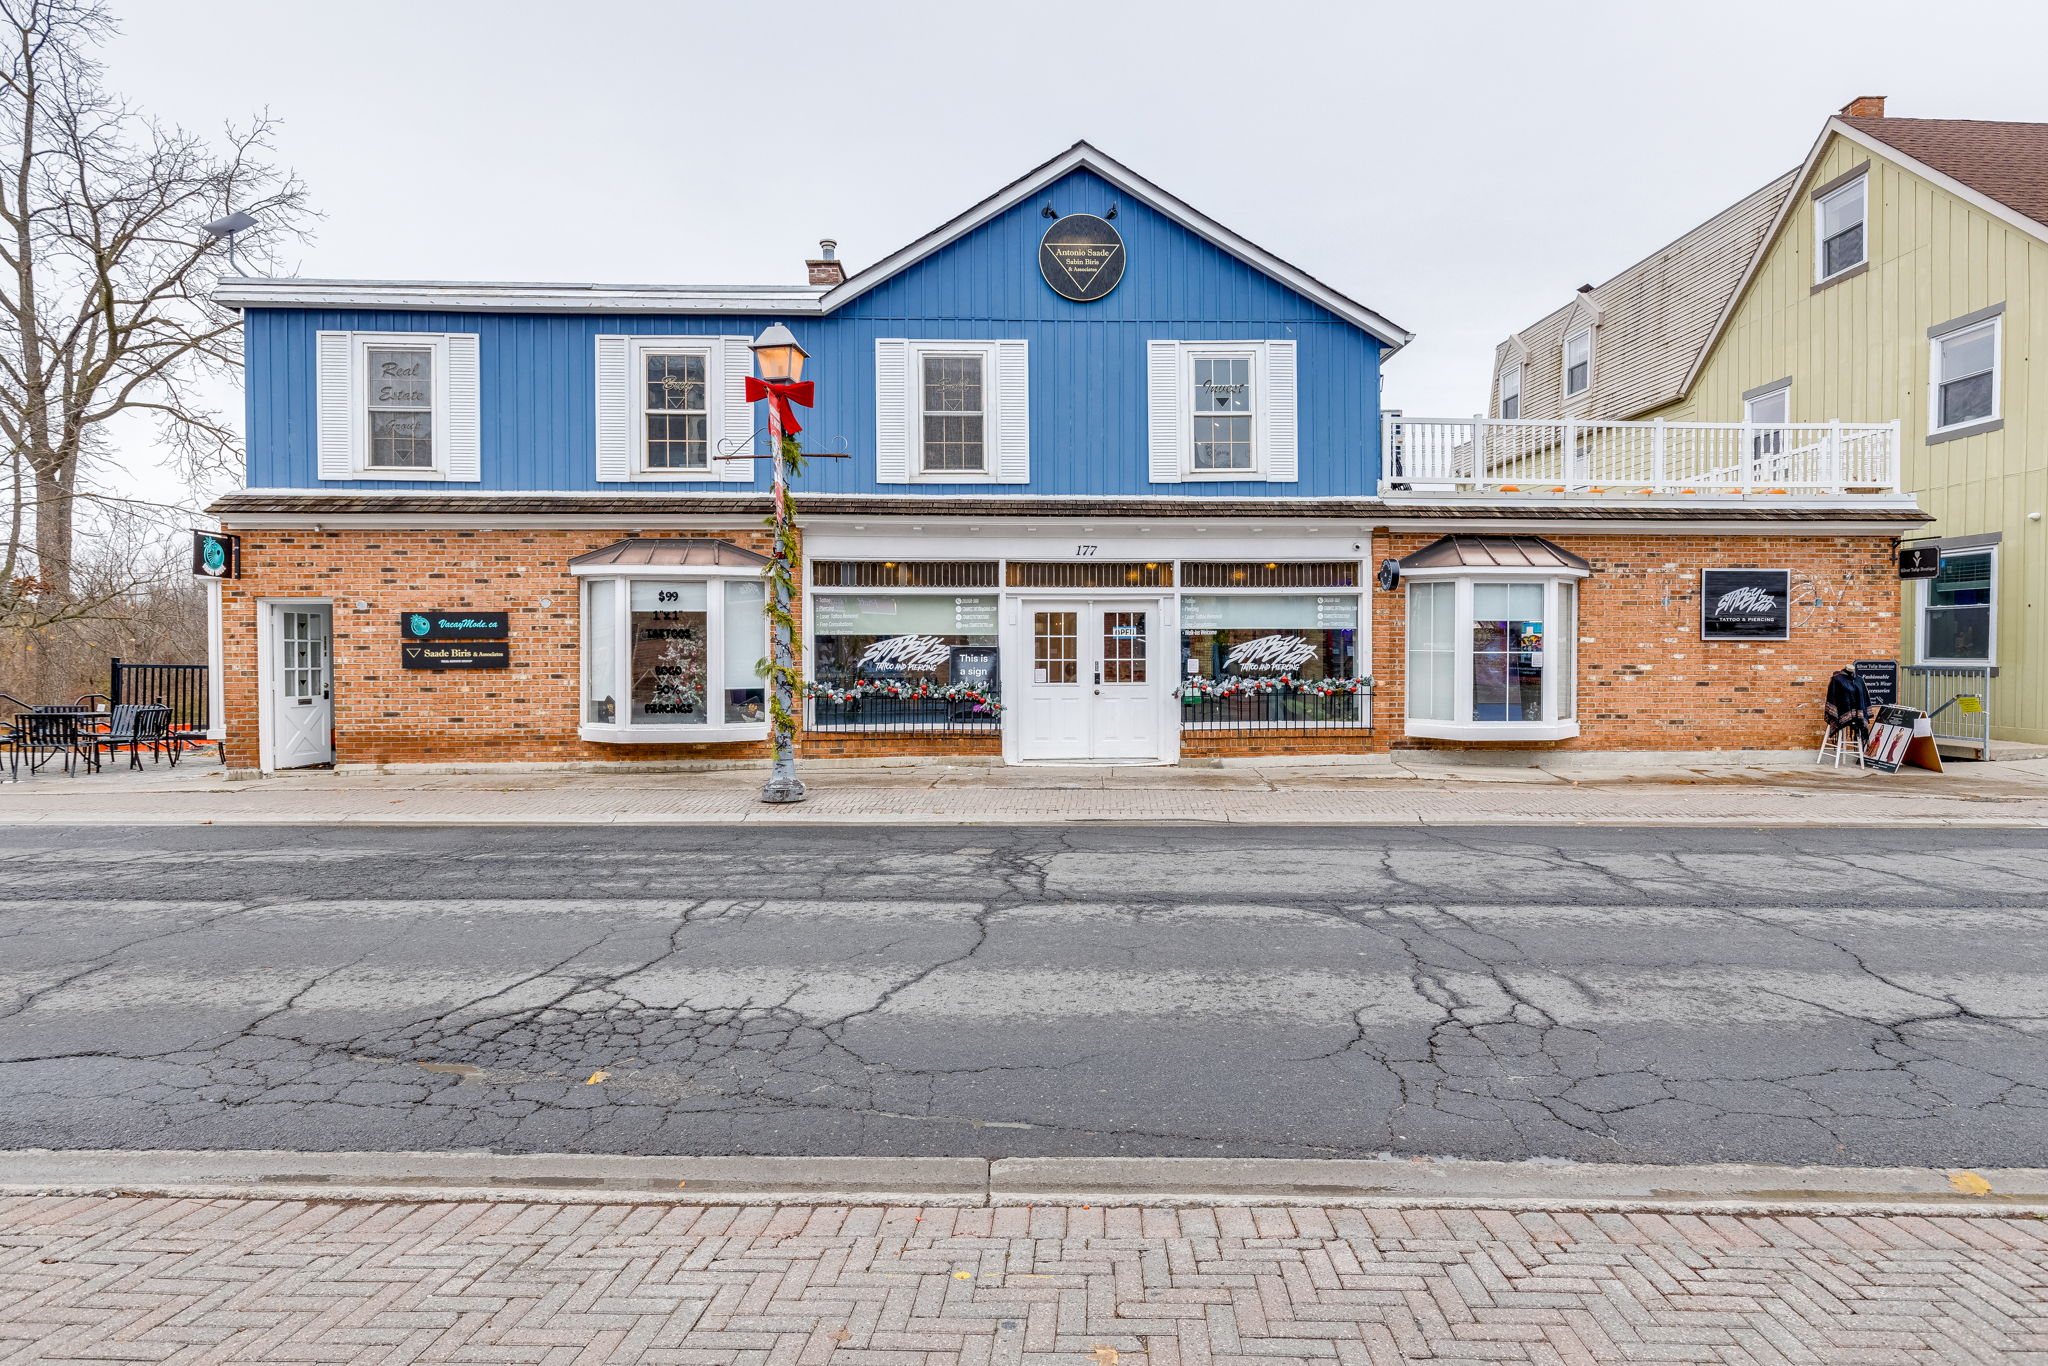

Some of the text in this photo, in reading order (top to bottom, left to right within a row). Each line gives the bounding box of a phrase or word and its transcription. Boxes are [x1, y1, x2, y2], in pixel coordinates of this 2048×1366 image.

[1056, 248, 1110, 256] Antonio Saade
[382, 362, 420, 378] Real
[1203, 380, 1244, 394] Invest
[379, 386, 424, 402] Estate
[1076, 545, 1098, 556] 177
[658, 590, 679, 602] $99
[438, 618, 498, 630] VacayMode.ca
[424, 648, 450, 658] Saade
[450, 648, 472, 658] Biris
[960, 654, 988, 662] This is
[875, 662, 938, 672] TATTOO AND PIERCING
[968, 667, 988, 677] sign
[1240, 662, 1300, 672] TATTOO AND PIERCING
[656, 684, 681, 696] 50%
